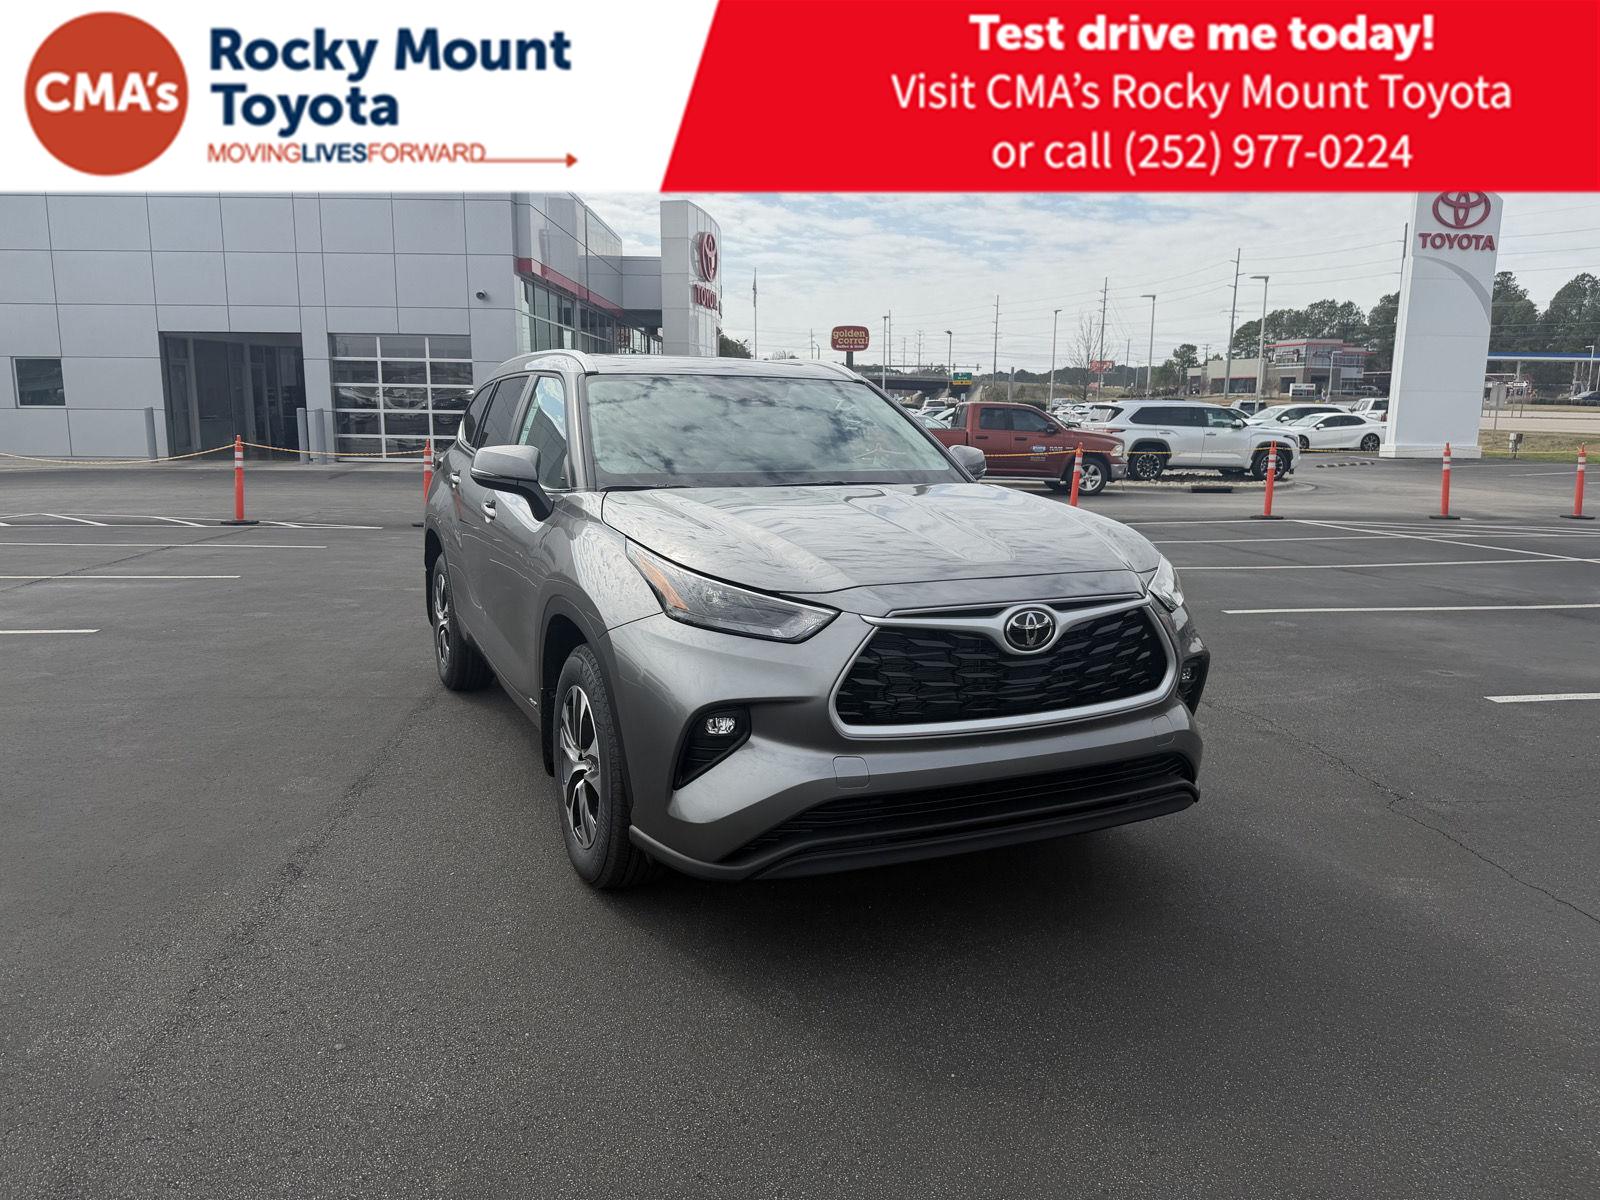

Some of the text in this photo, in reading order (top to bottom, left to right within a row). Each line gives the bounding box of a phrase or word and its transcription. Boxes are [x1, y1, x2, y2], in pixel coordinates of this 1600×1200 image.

[1418, 232, 1496, 251] TOYOTA
[832, 329, 866, 340] golden
[837, 336, 869, 345] corral
